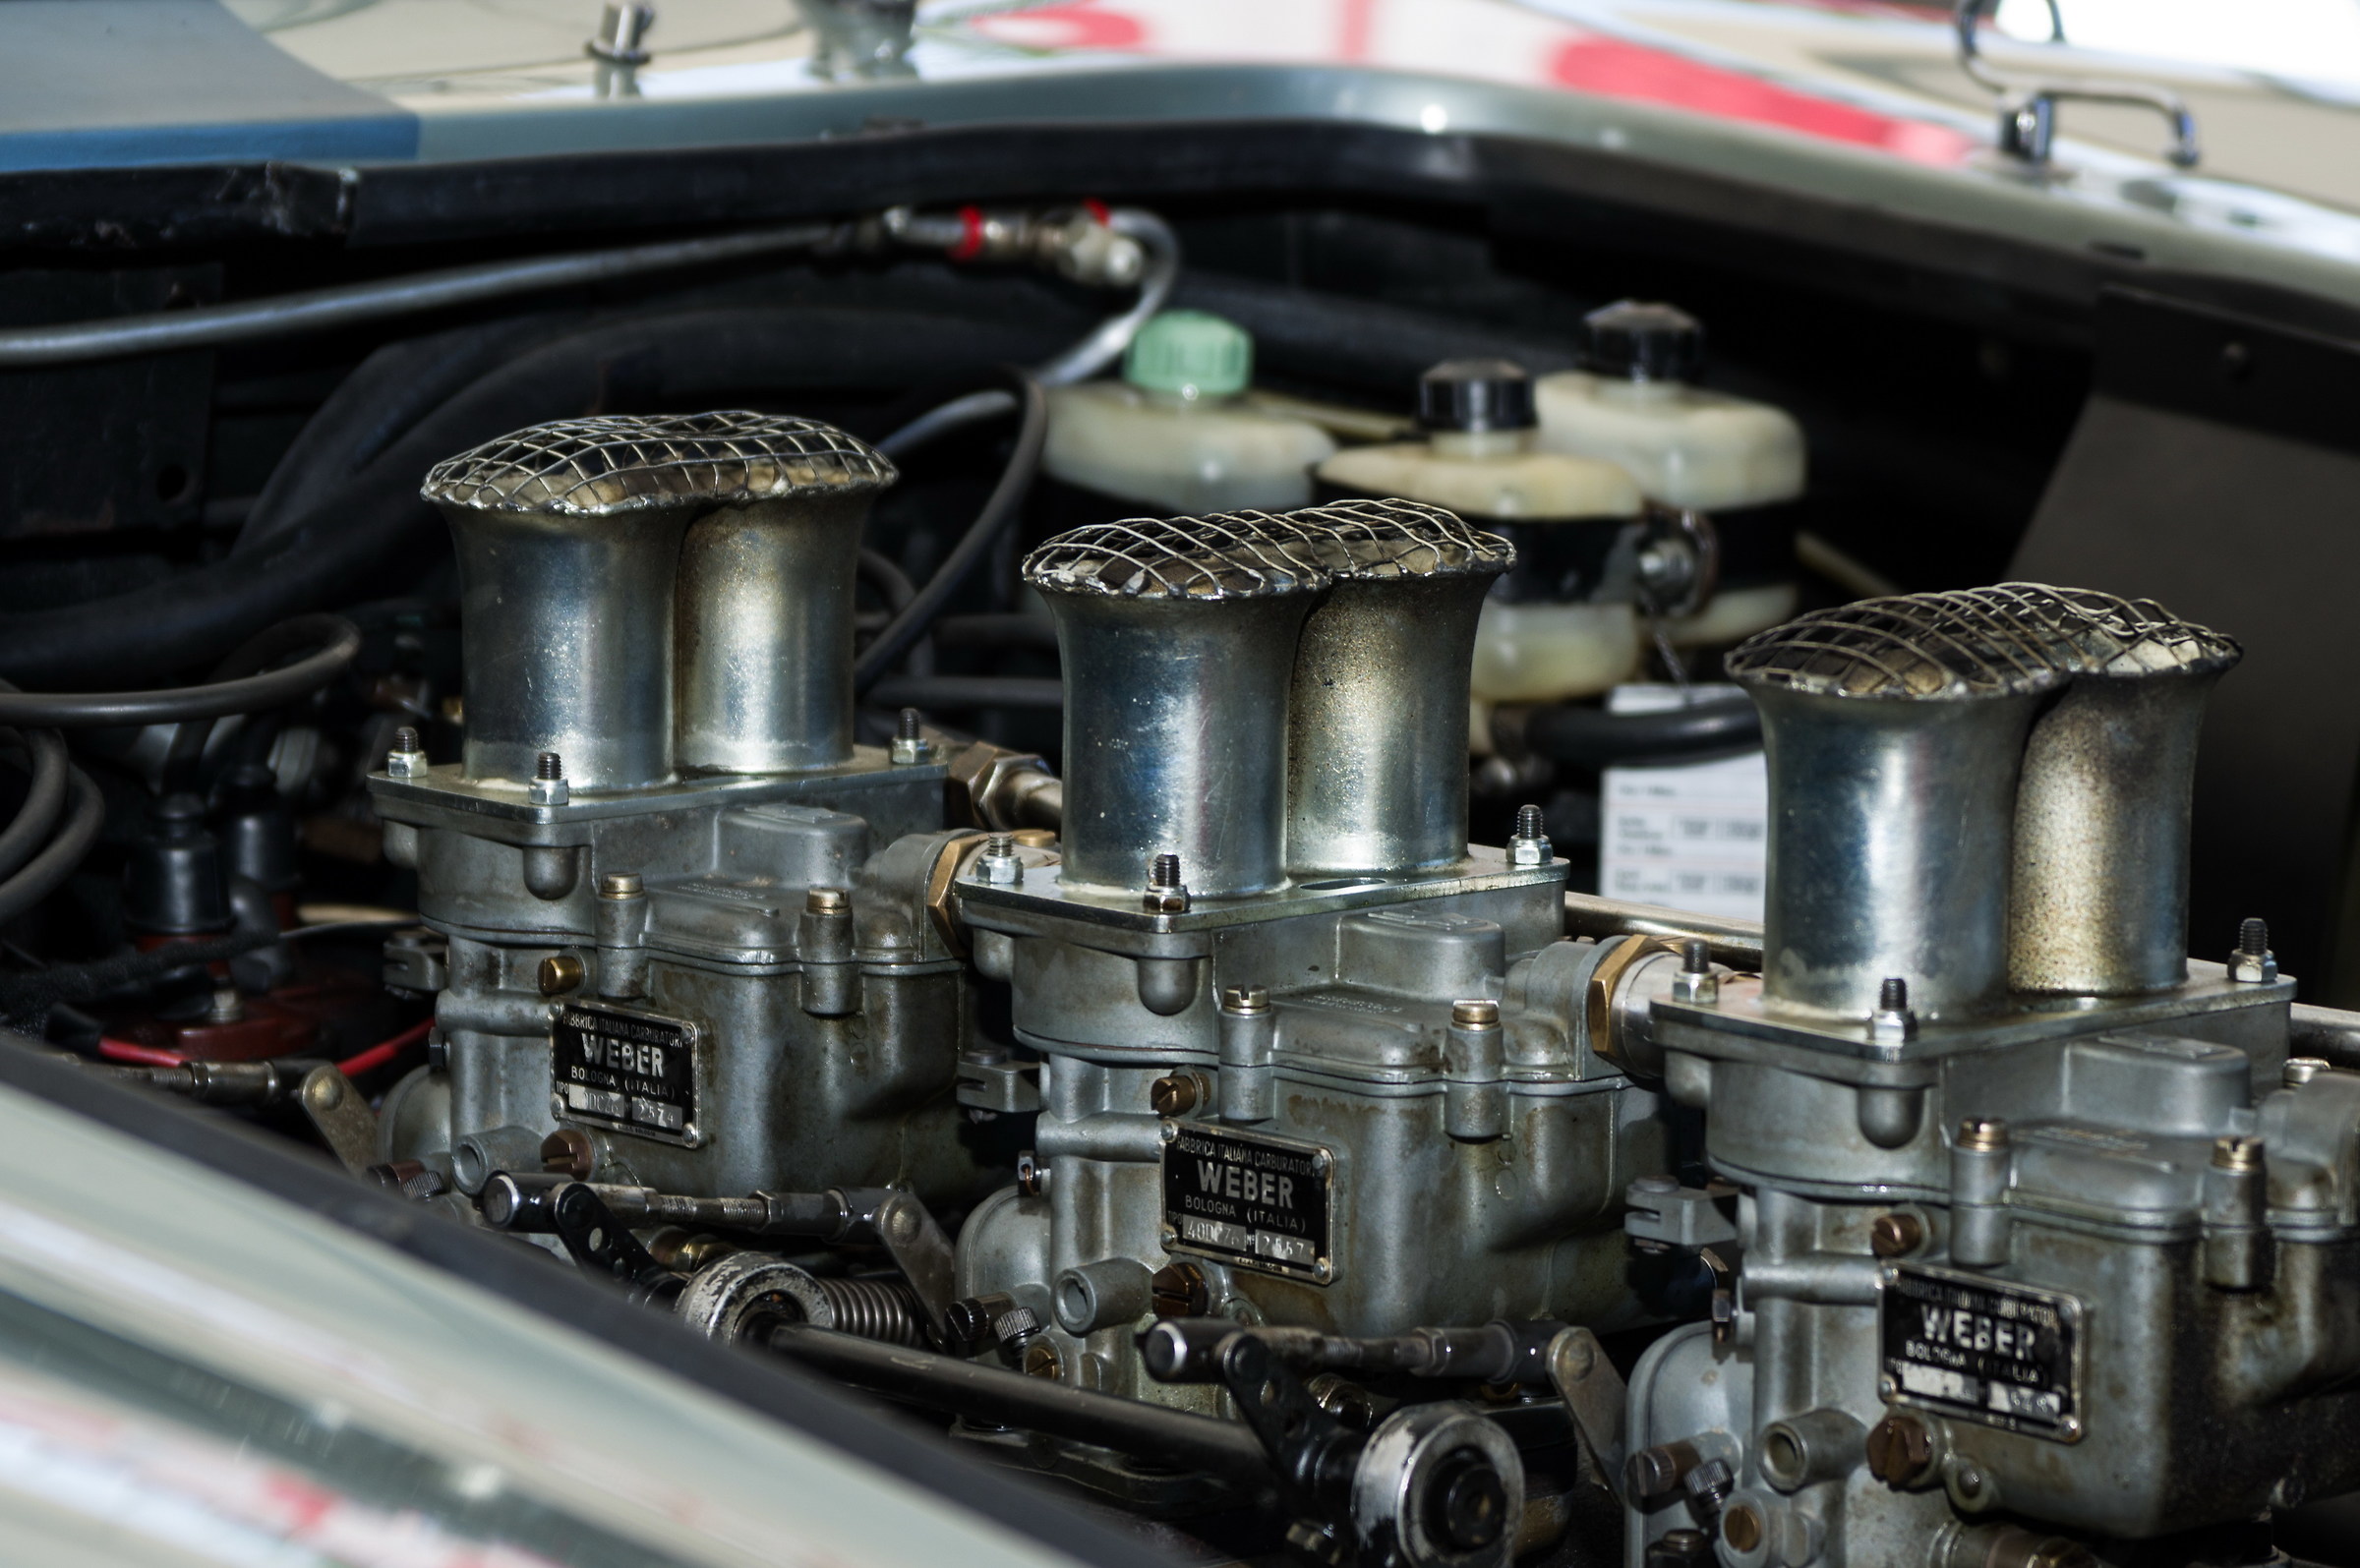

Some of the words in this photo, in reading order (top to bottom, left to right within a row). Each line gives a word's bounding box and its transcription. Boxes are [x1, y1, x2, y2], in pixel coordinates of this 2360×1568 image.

[599, 1018, 629, 1037] ITALIANA
[581, 1033, 664, 1077] WEBER
[571, 1066, 617, 1087] BOLOGNA
[624, 1076, 676, 1098] (ITALIA)
[1177, 1135, 1215, 1158] FABBRICA
[1217, 1143, 1253, 1164] ITALIANA
[1197, 1160, 1294, 1209] WEBER
[1167, 1210, 1183, 1226] TIPO
[1185, 1194, 1236, 1218] BOLOGNA
[1247, 1208, 1306, 1233] (ITALIA)
[1920, 1304, 2036, 1362] WEBER
[1906, 1340, 1967, 1367] BOLOGNA
